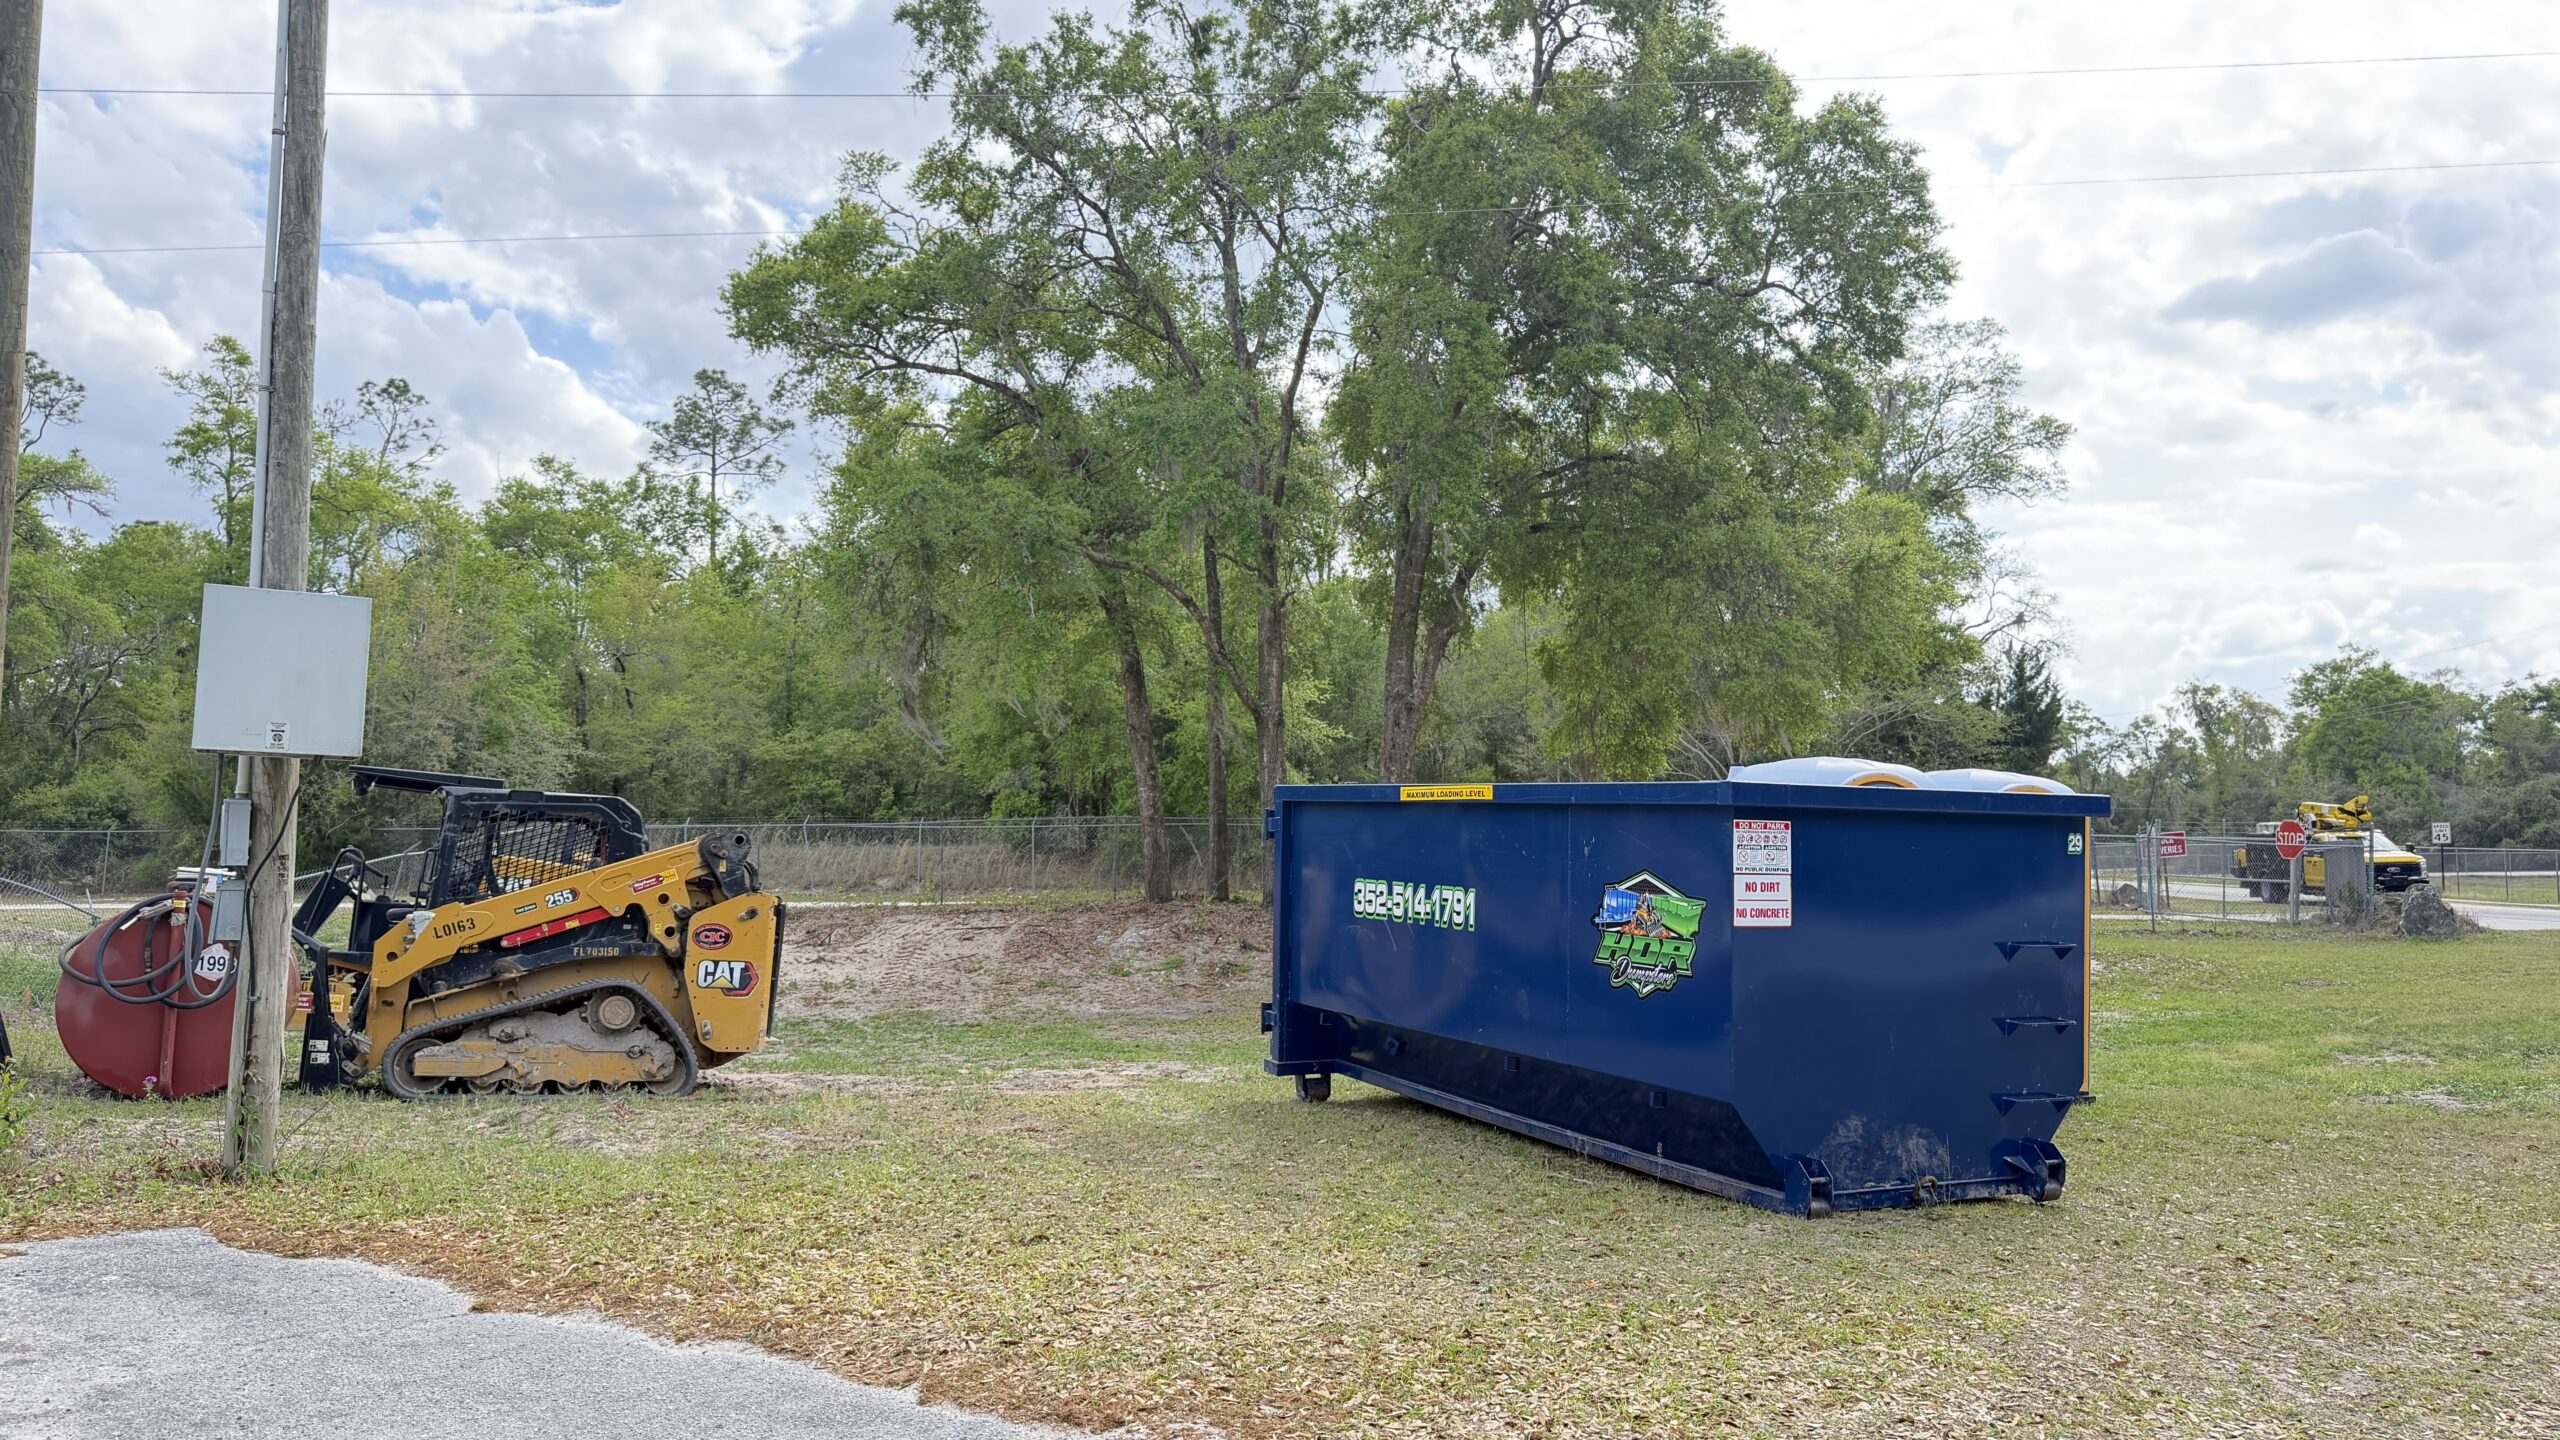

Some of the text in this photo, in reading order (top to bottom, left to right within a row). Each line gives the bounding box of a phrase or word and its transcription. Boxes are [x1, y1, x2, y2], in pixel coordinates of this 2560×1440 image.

[1407, 790, 1486, 799] MAXIMUM LOADING LEVEL
[1740, 821, 1786, 831] DO NOT PARK
[2068, 833, 2083, 855] 29
[2278, 831, 2304, 846] STOP
[2434, 833, 2449, 842] 45
[1745, 881, 1781, 893] NO DIRT
[544, 888, 573, 909] 255
[1354, 878, 1476, 932] 352-514-1791
[1736, 907, 1790, 919] NO CONCRETE
[700, 931, 726, 943] CIC
[1597, 931, 1694, 971] HDR
[698, 960, 746, 989] CAT
[1611, 956, 1676, 994] Dumpsters
